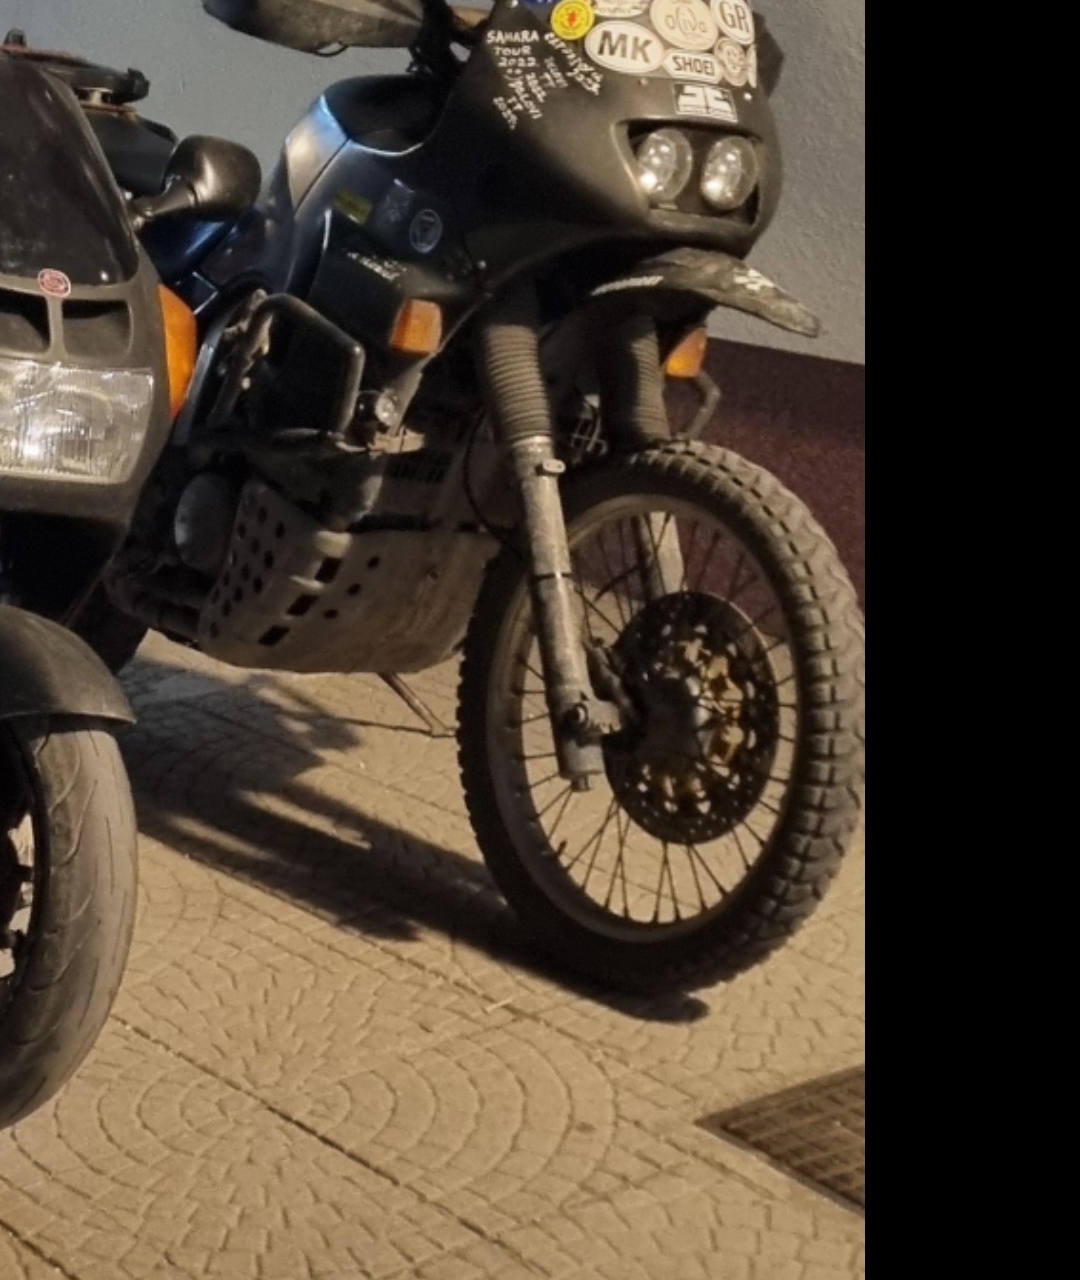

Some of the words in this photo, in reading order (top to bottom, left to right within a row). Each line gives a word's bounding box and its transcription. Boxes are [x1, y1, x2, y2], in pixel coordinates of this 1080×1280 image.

[720, 0, 749, 34] GR
[486, 29, 540, 44] SAHARA
[597, 30, 652, 64] MK
[493, 45, 531, 56] TOUR
[672, 54, 716, 77] SHOEI
